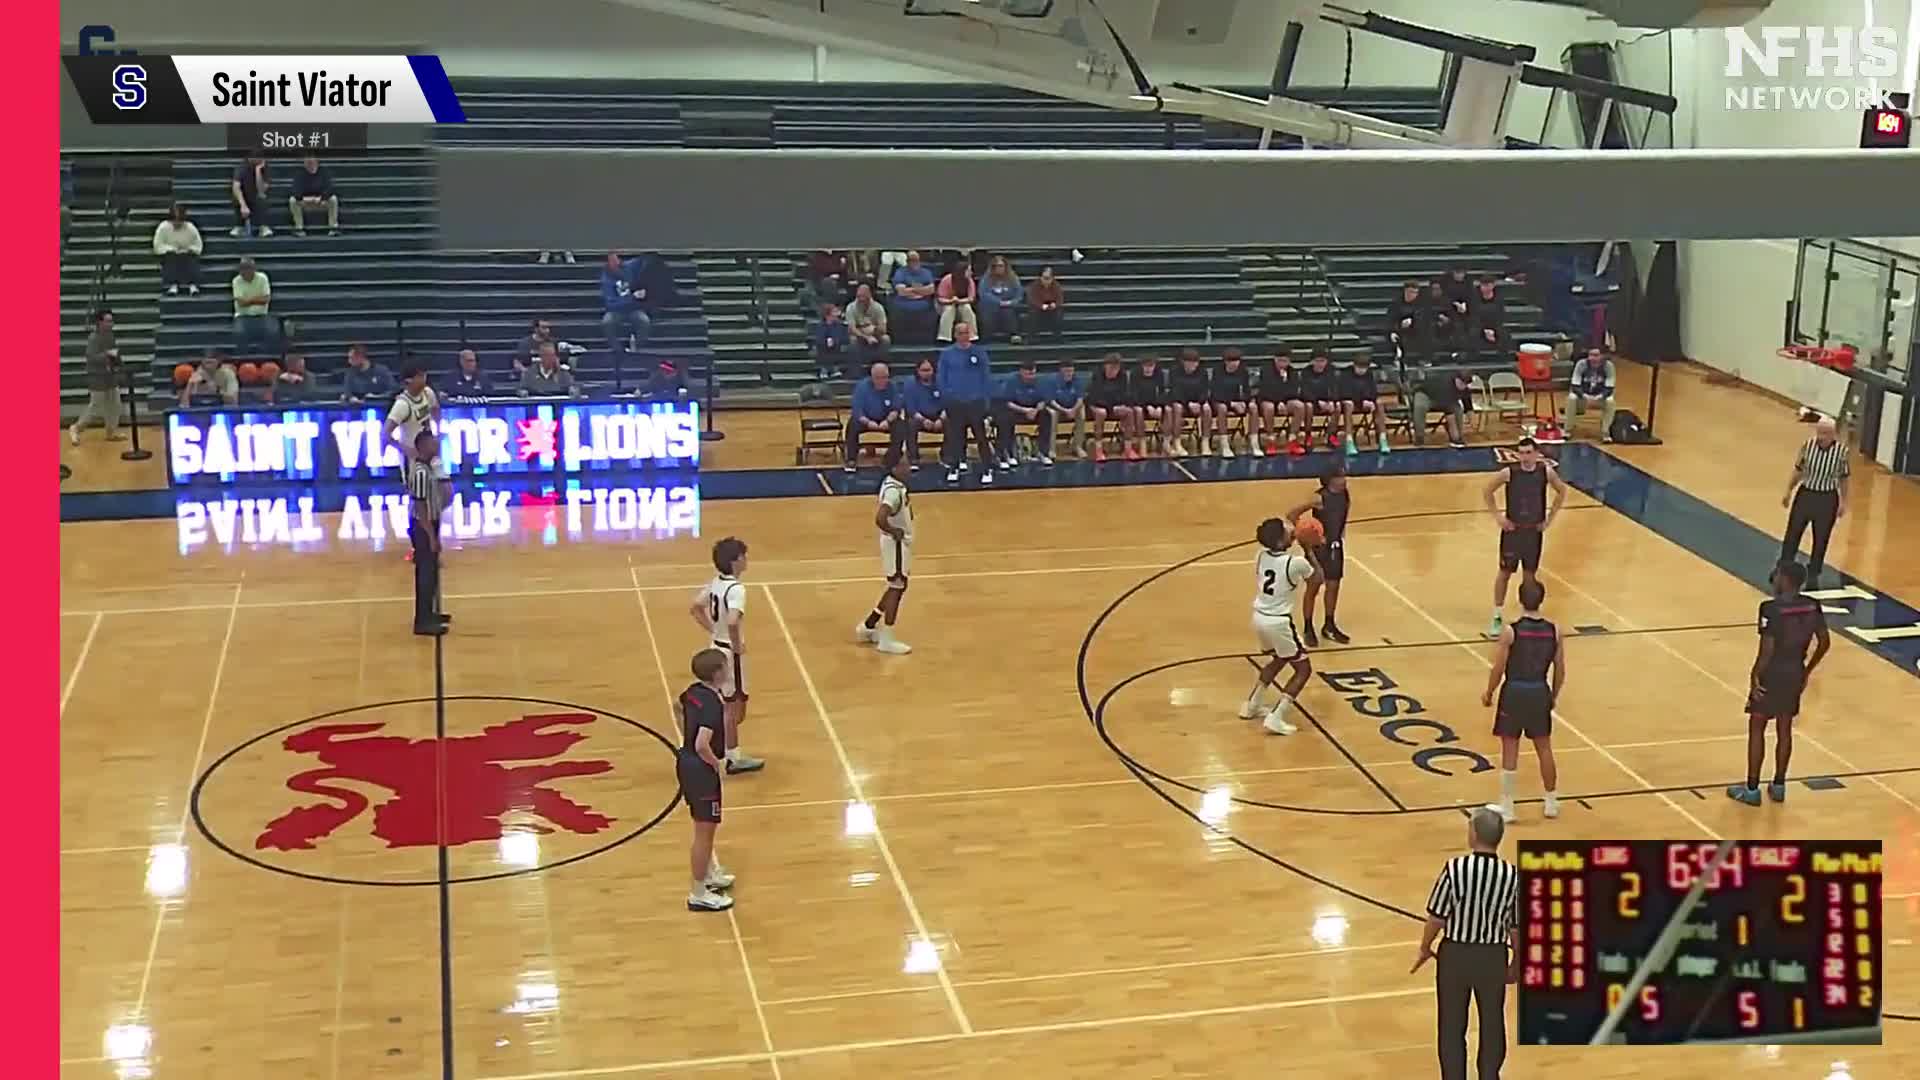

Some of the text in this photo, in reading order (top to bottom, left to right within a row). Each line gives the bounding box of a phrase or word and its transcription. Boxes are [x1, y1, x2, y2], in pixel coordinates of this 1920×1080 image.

[170, 422, 319, 475] SAINT
[563, 411, 697, 463] LIONS
[1263, 569, 1276, 595] 2
[1316, 667, 1496, 776] ESCC
[1668, 843, 1743, 889] 6:54
[1618, 871, 1641, 917] 2
[1781, 874, 1805, 922] 2
[1738, 915, 1748, 945] 1
[1641, 986, 1660, 1020] 5
[1738, 992, 1758, 1028] 5
[1793, 998, 1804, 1029] 1
